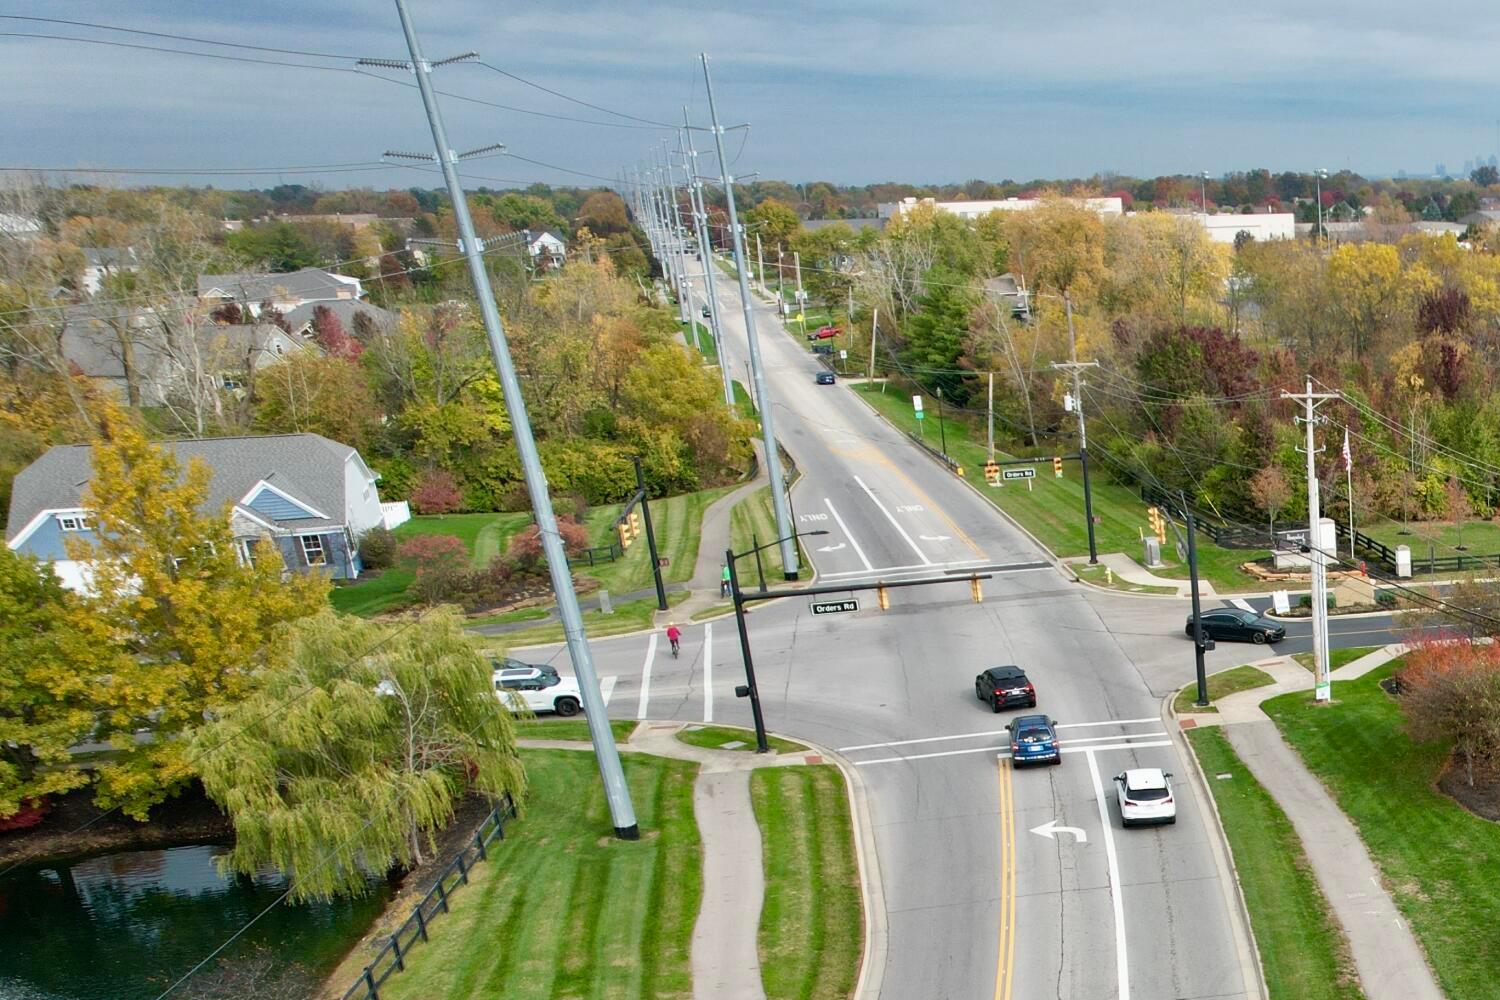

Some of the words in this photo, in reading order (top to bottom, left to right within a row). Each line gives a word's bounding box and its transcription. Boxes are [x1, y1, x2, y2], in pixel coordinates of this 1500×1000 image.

[799, 513, 828, 522] ONLY
[816, 604, 841, 613] Orders
[843, 602, 855, 610] Rd
